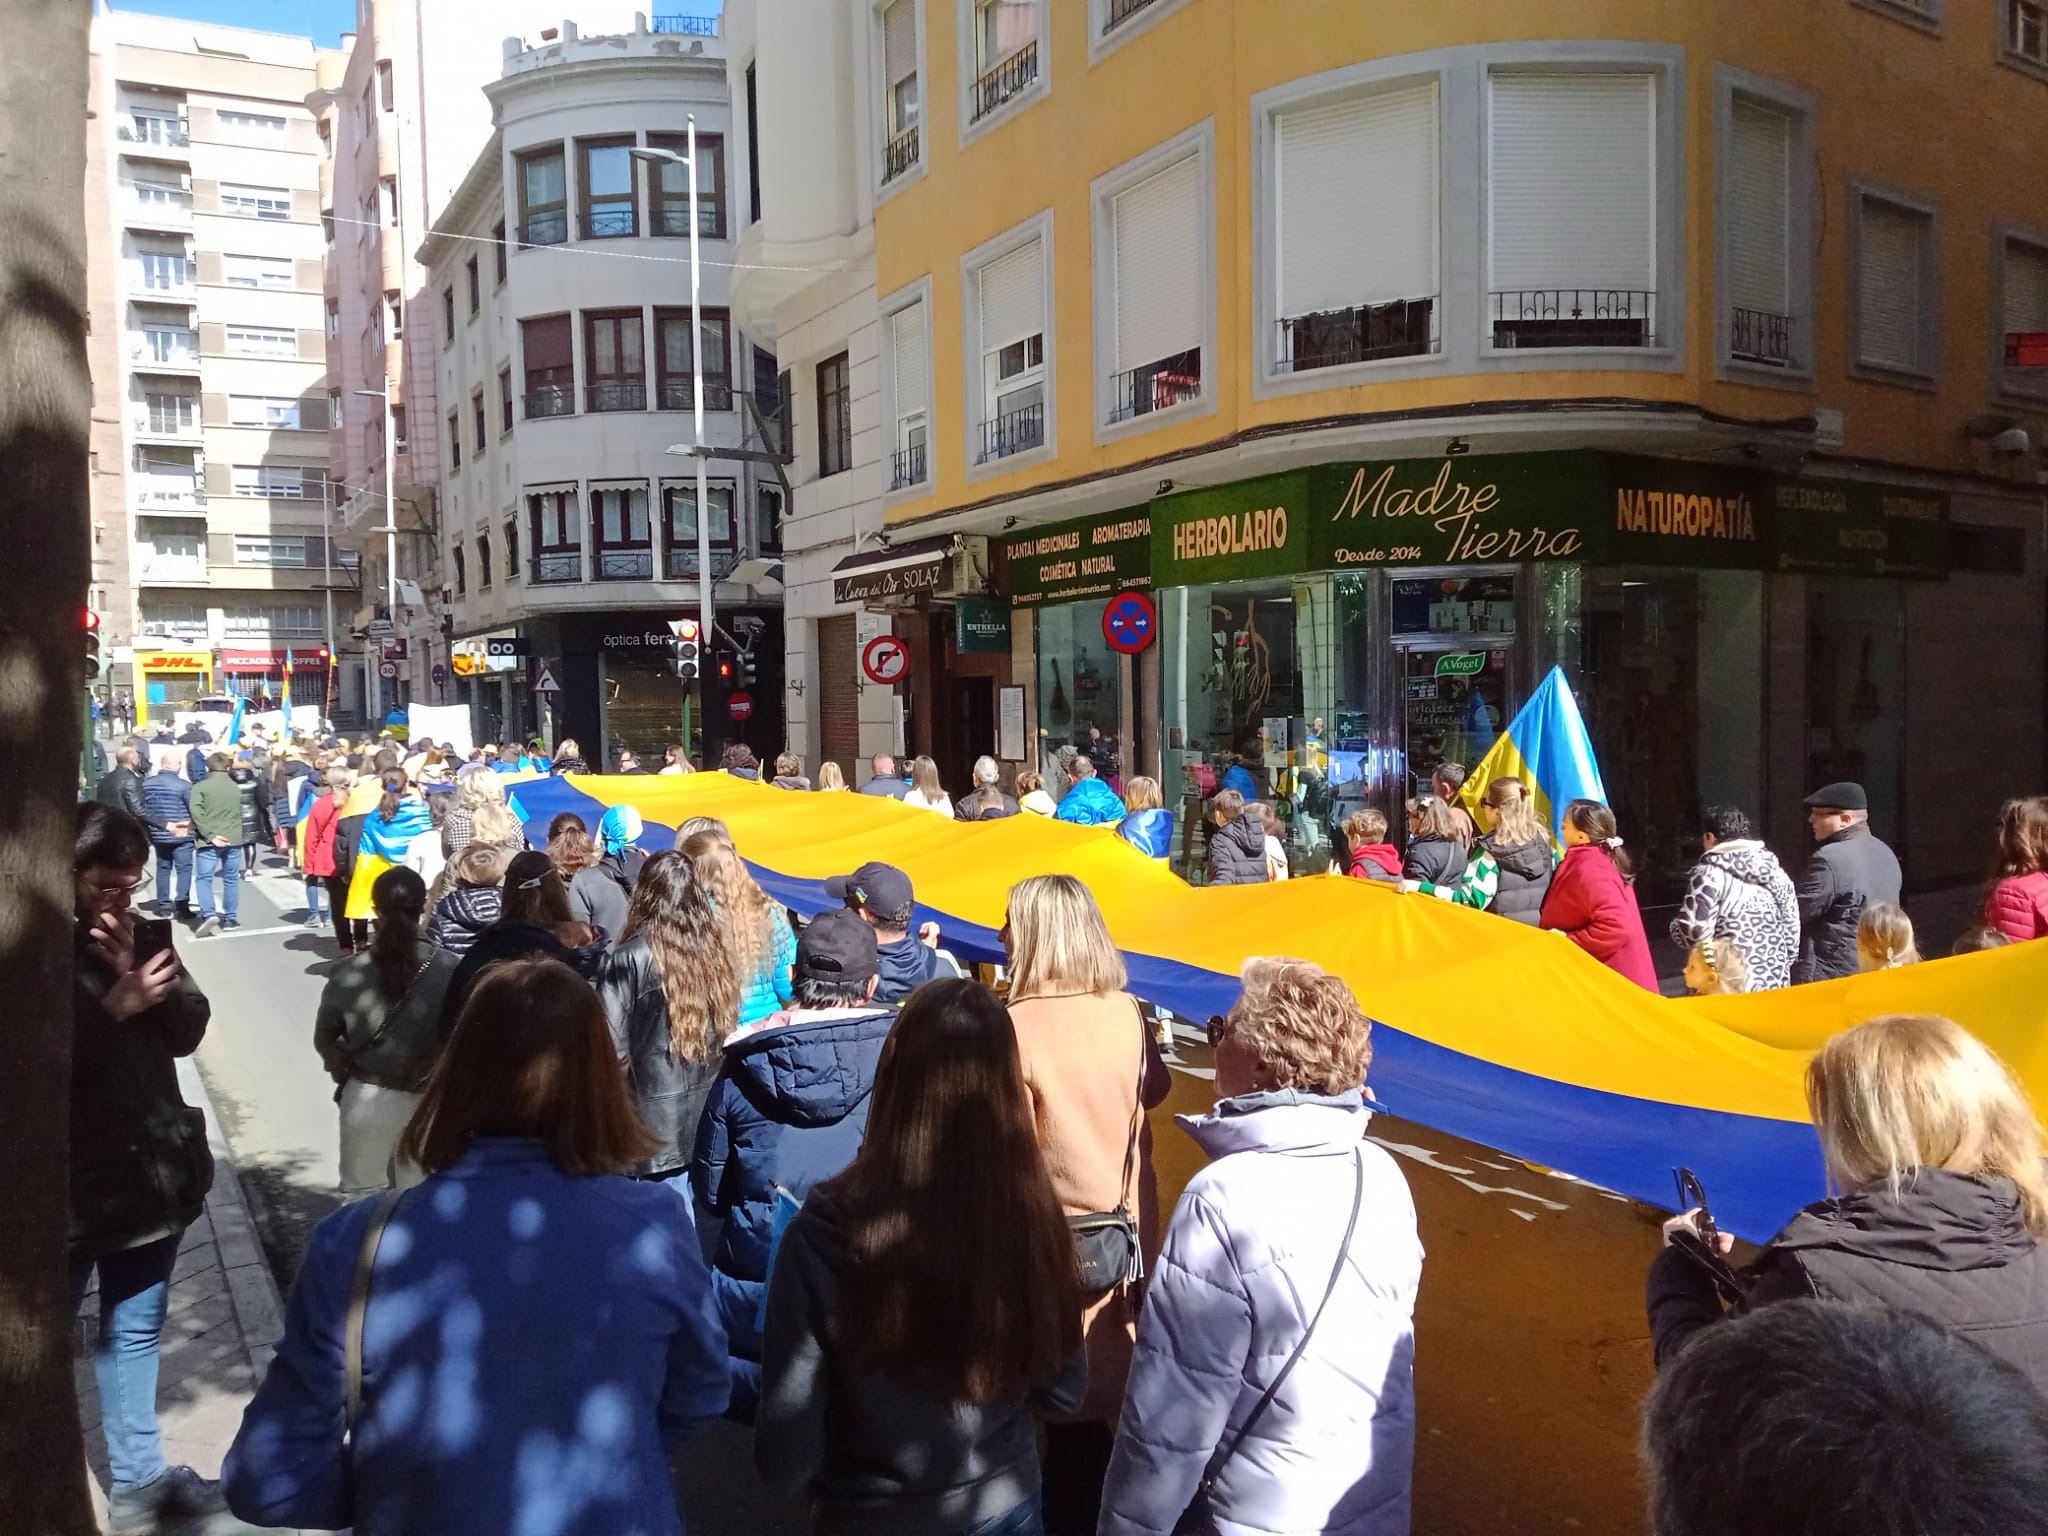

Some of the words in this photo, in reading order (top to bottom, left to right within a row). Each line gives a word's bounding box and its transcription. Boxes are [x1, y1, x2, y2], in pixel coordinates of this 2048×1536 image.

[1331, 459, 1500, 521] Madre
[1616, 487, 1756, 541] NATUROPATÍA
[1092, 517, 1151, 545] AROMATERAPIA
[1173, 506, 1288, 561] HERBOLARIO
[1434, 510, 1582, 561] Tierra
[1007, 539, 1035, 561] PLANTAS
[1035, 531, 1080, 555] MEDICINALES
[1334, 547, 1386, 563] Desde
[1389, 546, 1422, 560] 2014
[903, 565, 940, 589] SOLAZ
[1039, 559, 1077, 583] COSMÉTICA
[1081, 554, 1116, 577] NATURAL
[966, 623, 1007, 631] ESTRELLA
[143, 657, 203, 668] DHL
[226, 657, 284, 667] PICCADILLY
[289, 657, 321, 667] OFFEE
